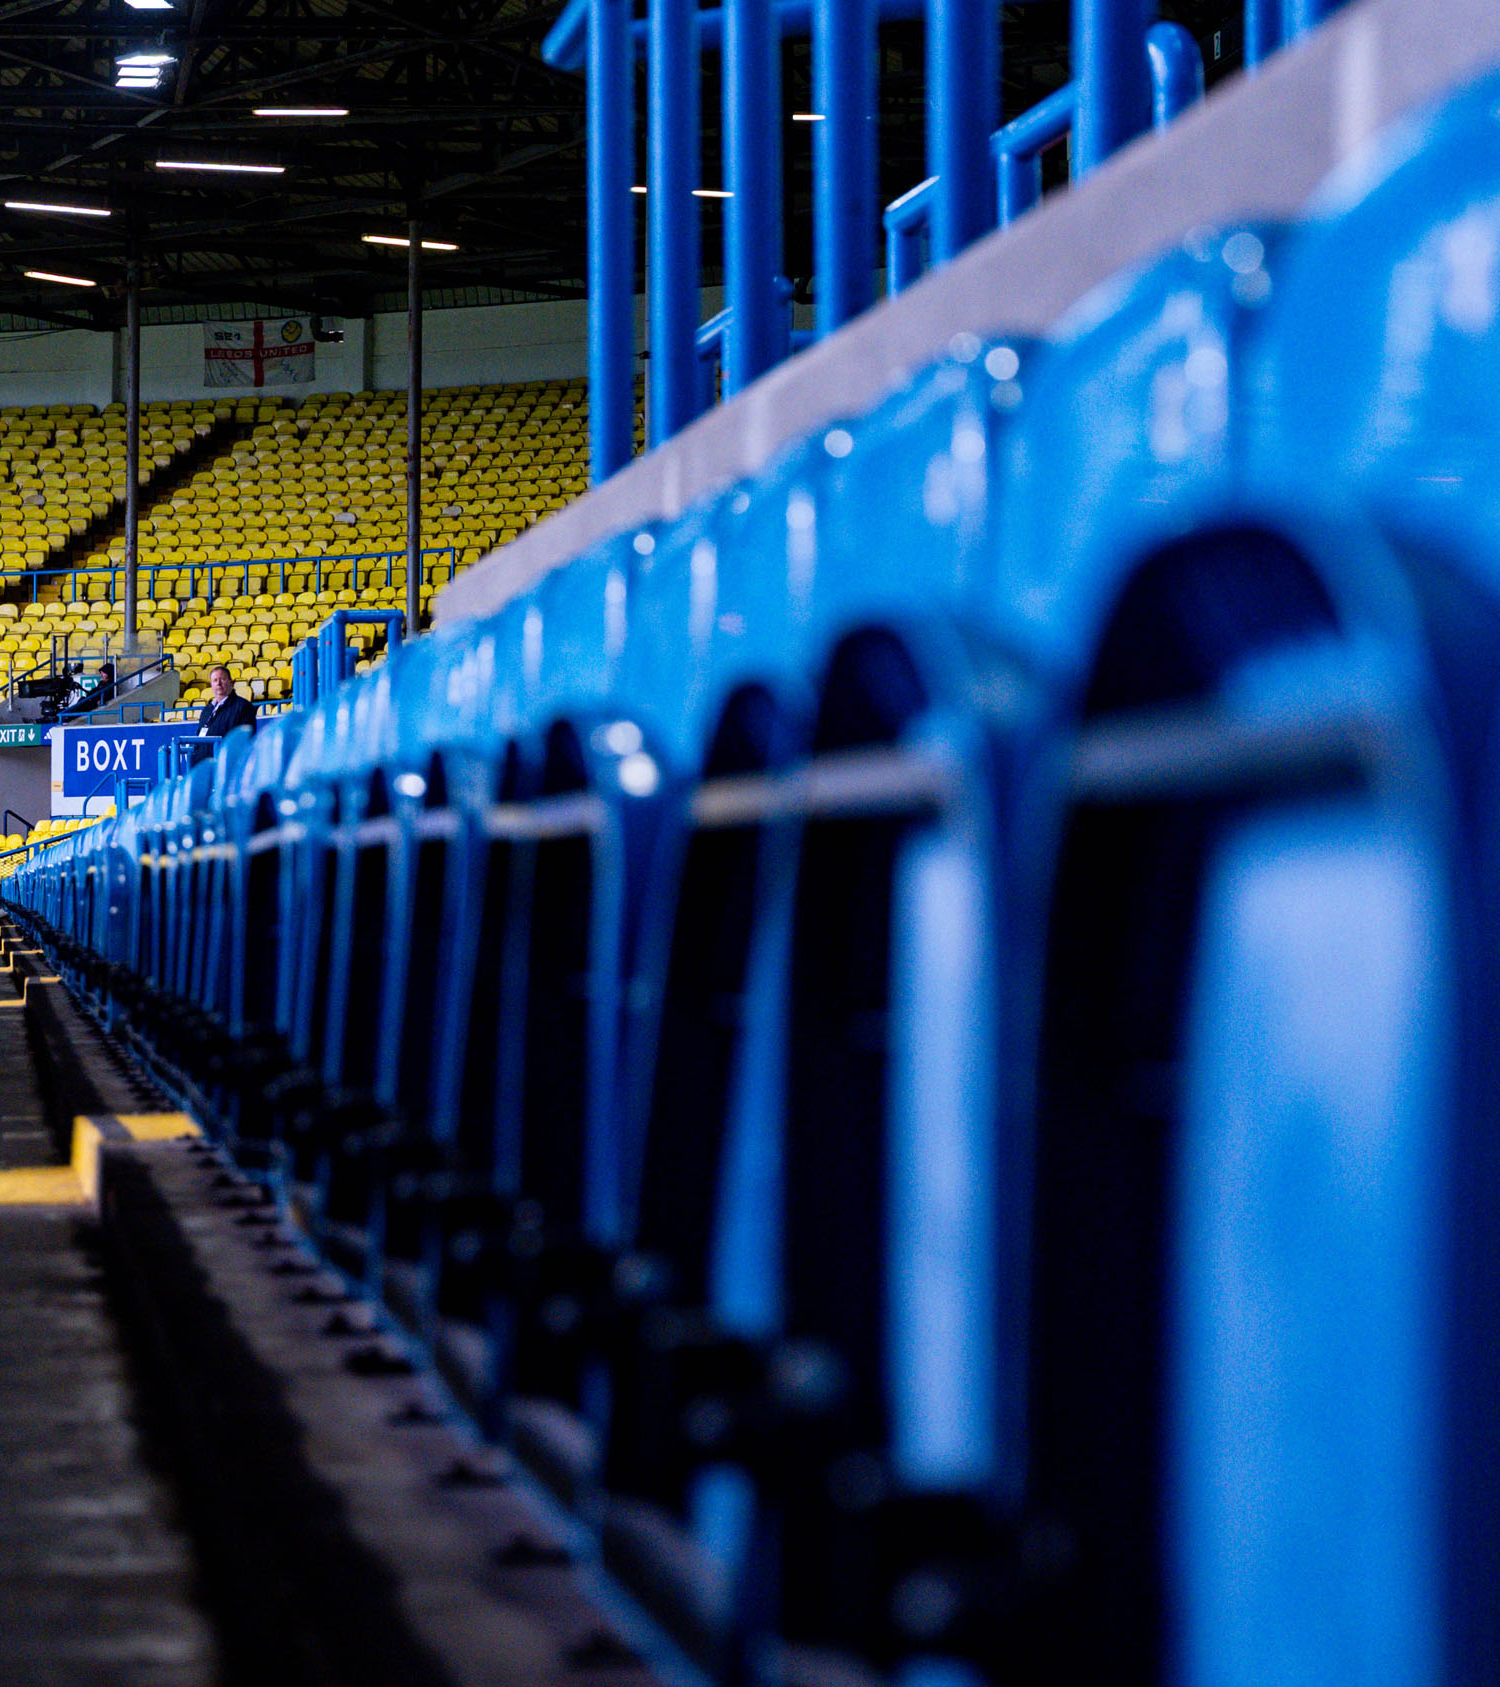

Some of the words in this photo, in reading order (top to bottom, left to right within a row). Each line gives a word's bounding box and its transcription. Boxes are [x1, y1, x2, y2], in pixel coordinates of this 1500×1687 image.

[210, 349, 253, 359] LEEDS
[259, 344, 309, 359] UNITED
[76, 738, 145, 772] BOXT
